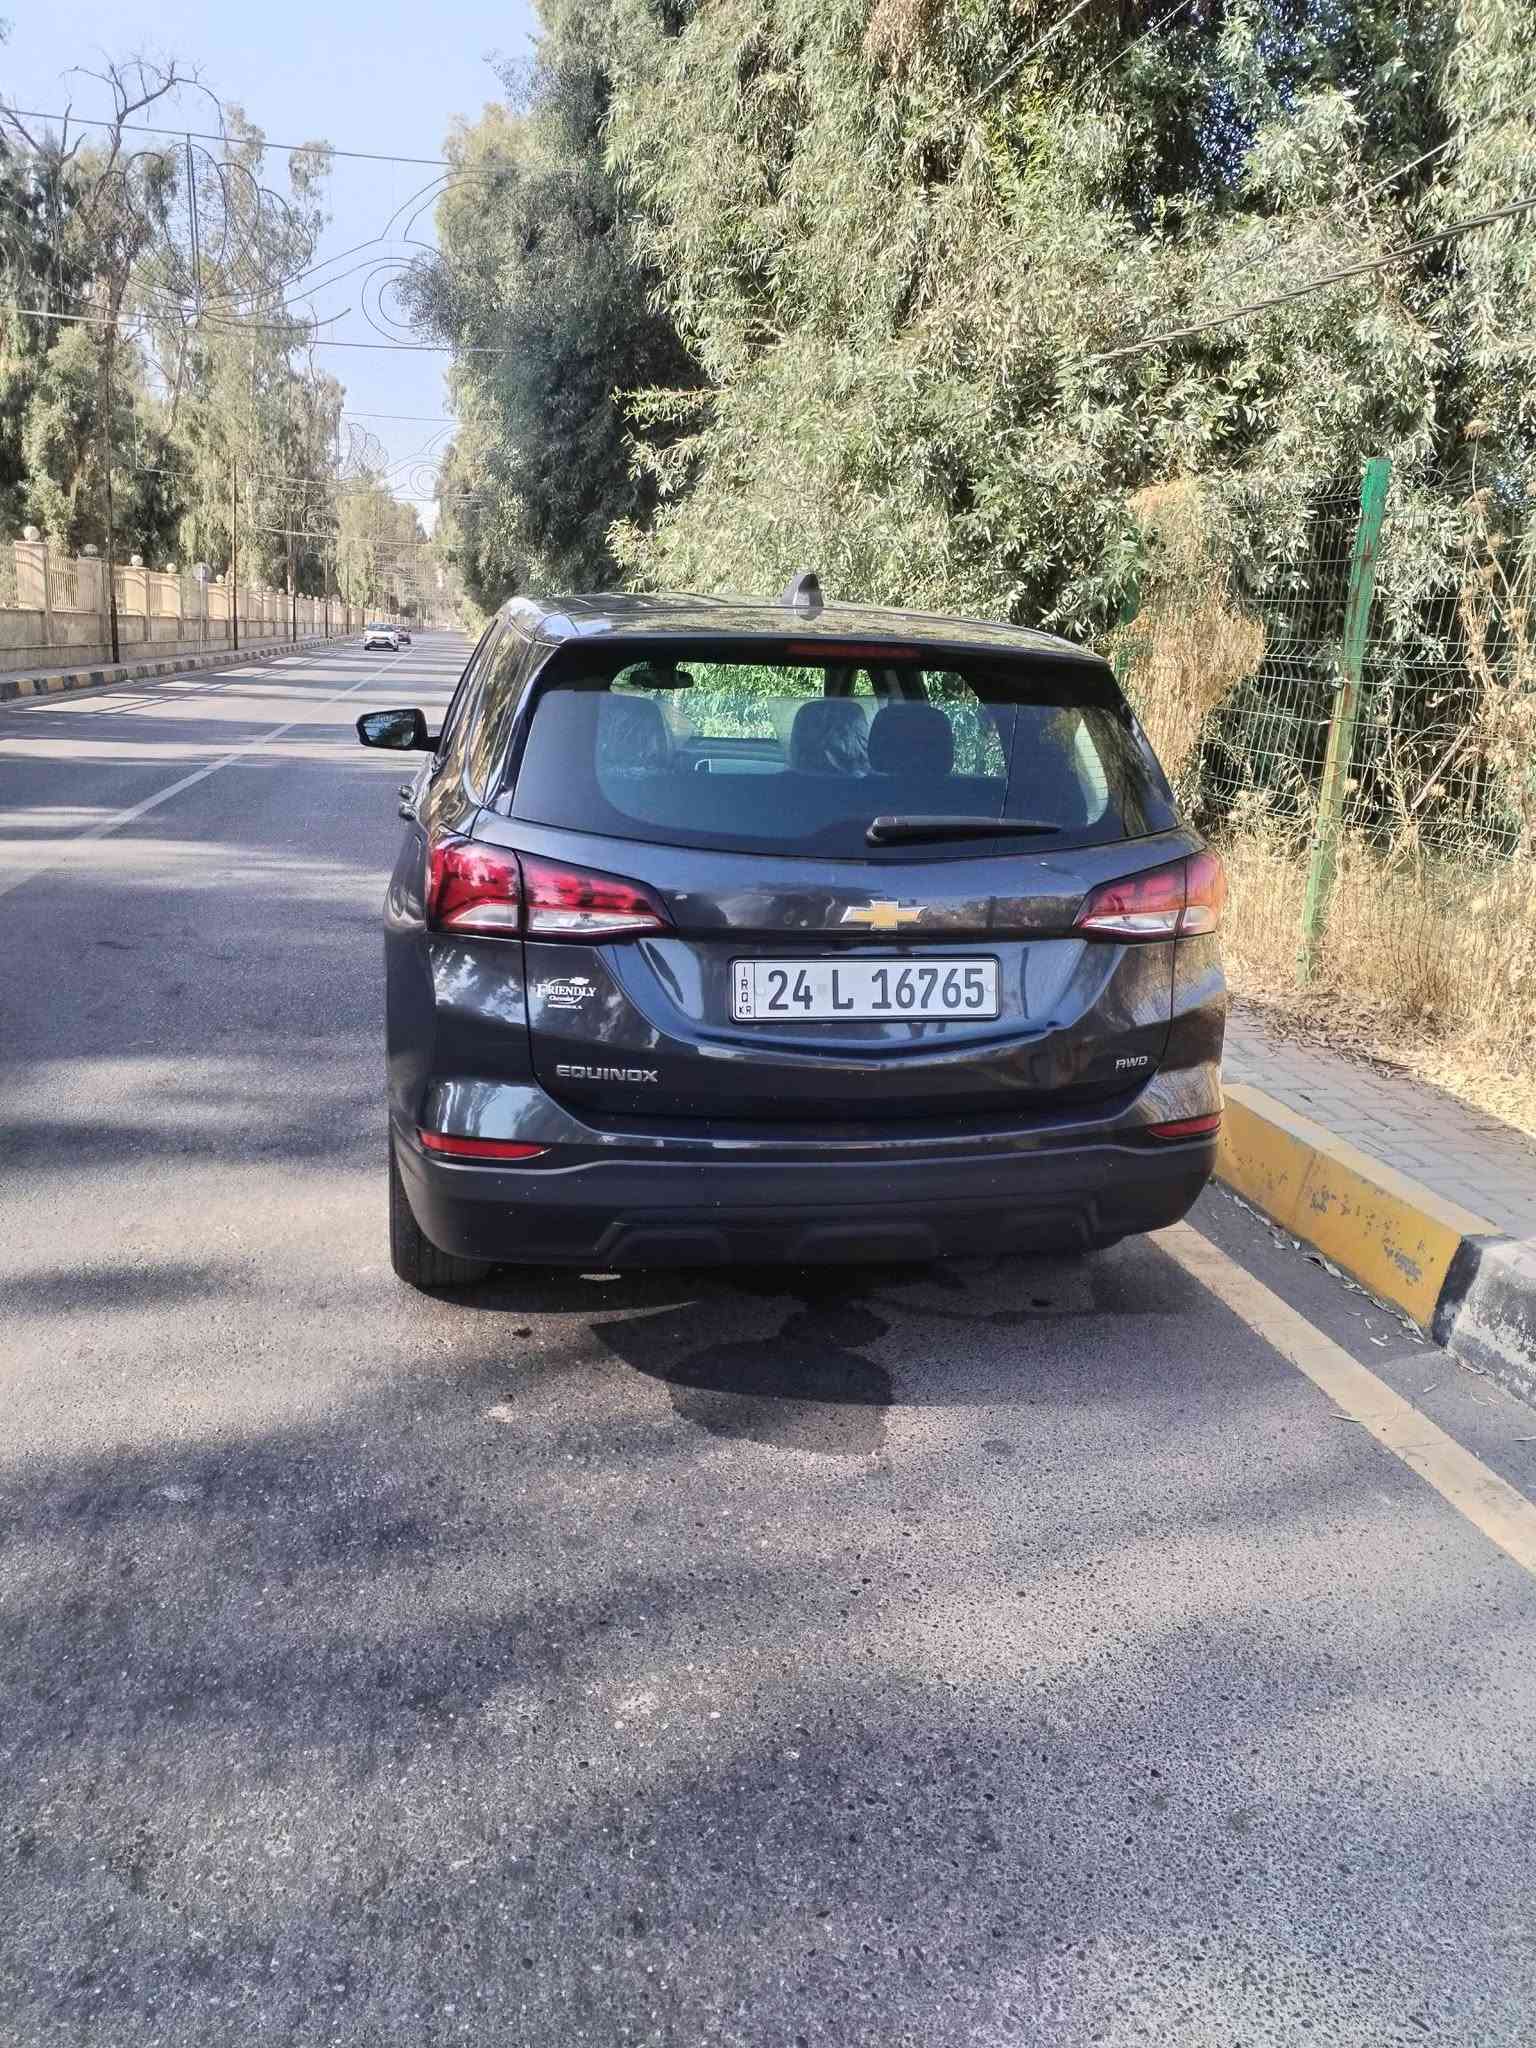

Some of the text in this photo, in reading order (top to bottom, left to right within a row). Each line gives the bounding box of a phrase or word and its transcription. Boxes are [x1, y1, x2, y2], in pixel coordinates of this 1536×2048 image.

[536, 983, 597, 998] FRIENDLY
[768, 968, 985, 1010] 24 L 16765
[556, 1064, 658, 1082] EQUINOX
